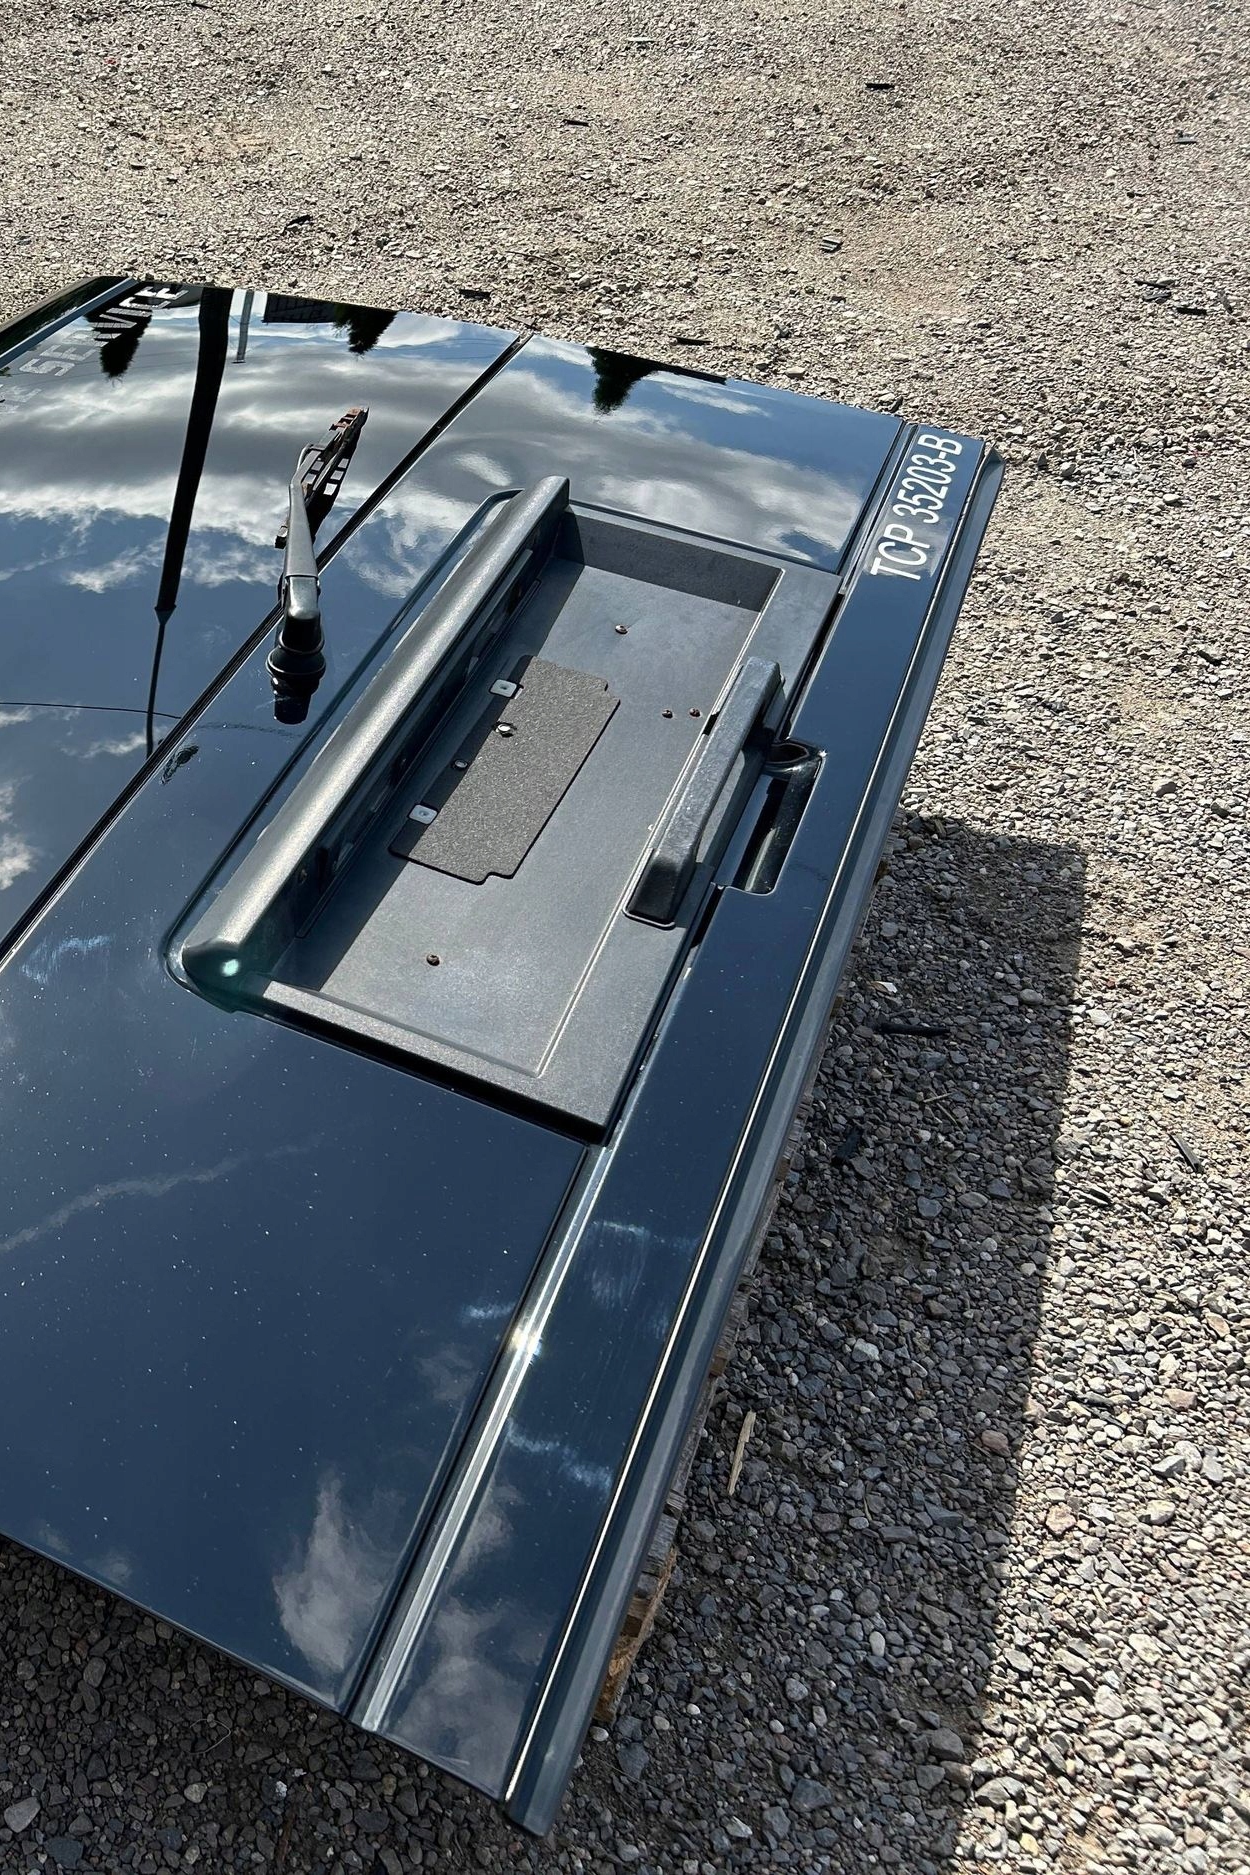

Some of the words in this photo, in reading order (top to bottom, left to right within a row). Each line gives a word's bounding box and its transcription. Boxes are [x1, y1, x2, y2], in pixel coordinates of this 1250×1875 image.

[18, 286, 189, 377] SERVICE
[892, 433, 963, 524] 35203-B
[870, 523, 931, 581] TCP
